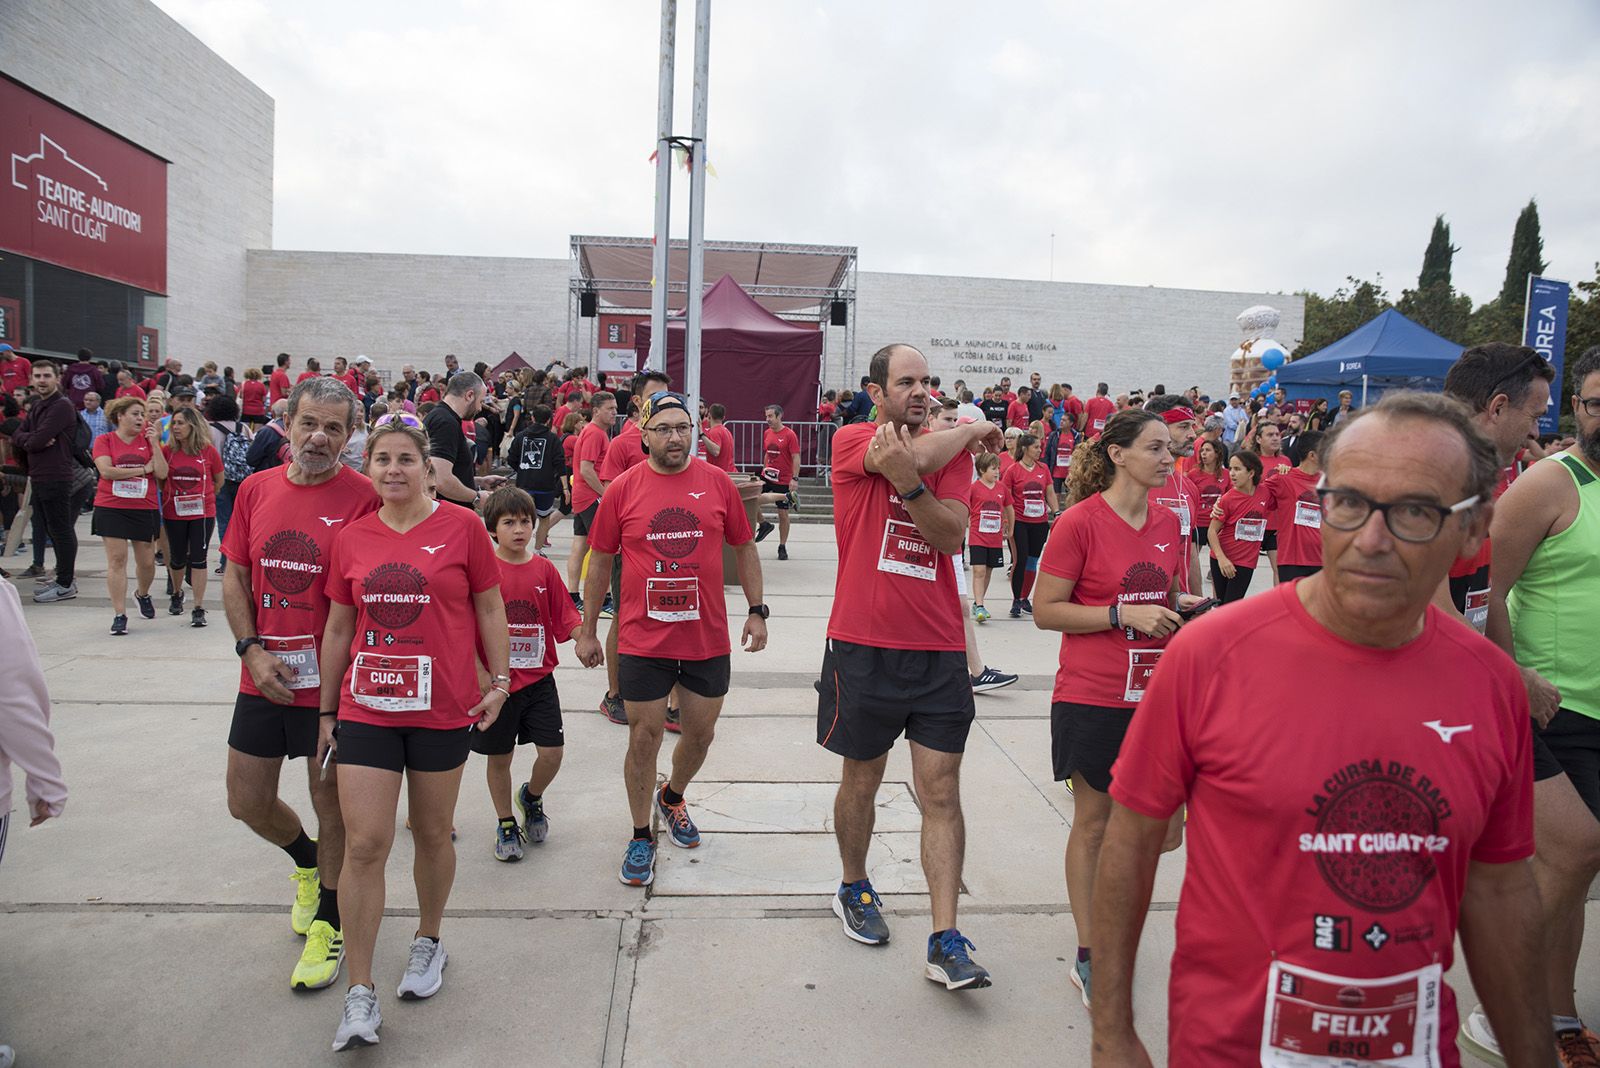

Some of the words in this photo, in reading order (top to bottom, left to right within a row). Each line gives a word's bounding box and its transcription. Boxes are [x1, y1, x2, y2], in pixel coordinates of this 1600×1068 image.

[36, 174, 142, 233] TEATRE-AUDITORI
[37, 200, 70, 231] SANT
[72, 213, 109, 243] CUGAT
[609, 325, 619, 342] RAC
[1535, 305, 1557, 363] OREA
[930, 338, 960, 348] ESCOLA
[965, 340, 1008, 350] MUNICIPAL
[1011, 342, 1021, 350] DE
[987, 353, 1004, 361] DELS
[959, 365, 1024, 375] CONSERVATORI
[1346, 362, 1361, 370] SOREA
[269, 529, 297, 541] CURSA
[298, 531, 309, 539] DE
[646, 532, 666, 541] SANT
[667, 531, 691, 539] CUGAT
[898, 540, 931, 555] RUBÉN
[260, 558, 281, 568] SANT
[281, 560, 309, 572] CUGAT
[369, 562, 398, 577] CURSA
[400, 562, 412, 571] DE
[1126, 561, 1147, 577] CURSA
[263, 593, 271, 607] RAC
[383, 593, 415, 603] CUGAT
[659, 595, 687, 606] 3517
[1117, 593, 1139, 602] SANT
[1140, 591, 1163, 600] CUGAT
[508, 642, 532, 652] 178
[370, 671, 404, 685] CUCA
[377, 687, 396, 695] 941
[1305, 794, 1328, 817] LA
[1322, 758, 1383, 794] CURSA
[1388, 760, 1416, 783] DE
[1299, 833, 1357, 852] SANT
[1359, 833, 1424, 853] CUGAT
[1315, 916, 1334, 949] RAC
[1280, 973, 1294, 994] RAC
[1311, 1011, 1391, 1037] FELIX
[1328, 1040, 1371, 1057] 630
